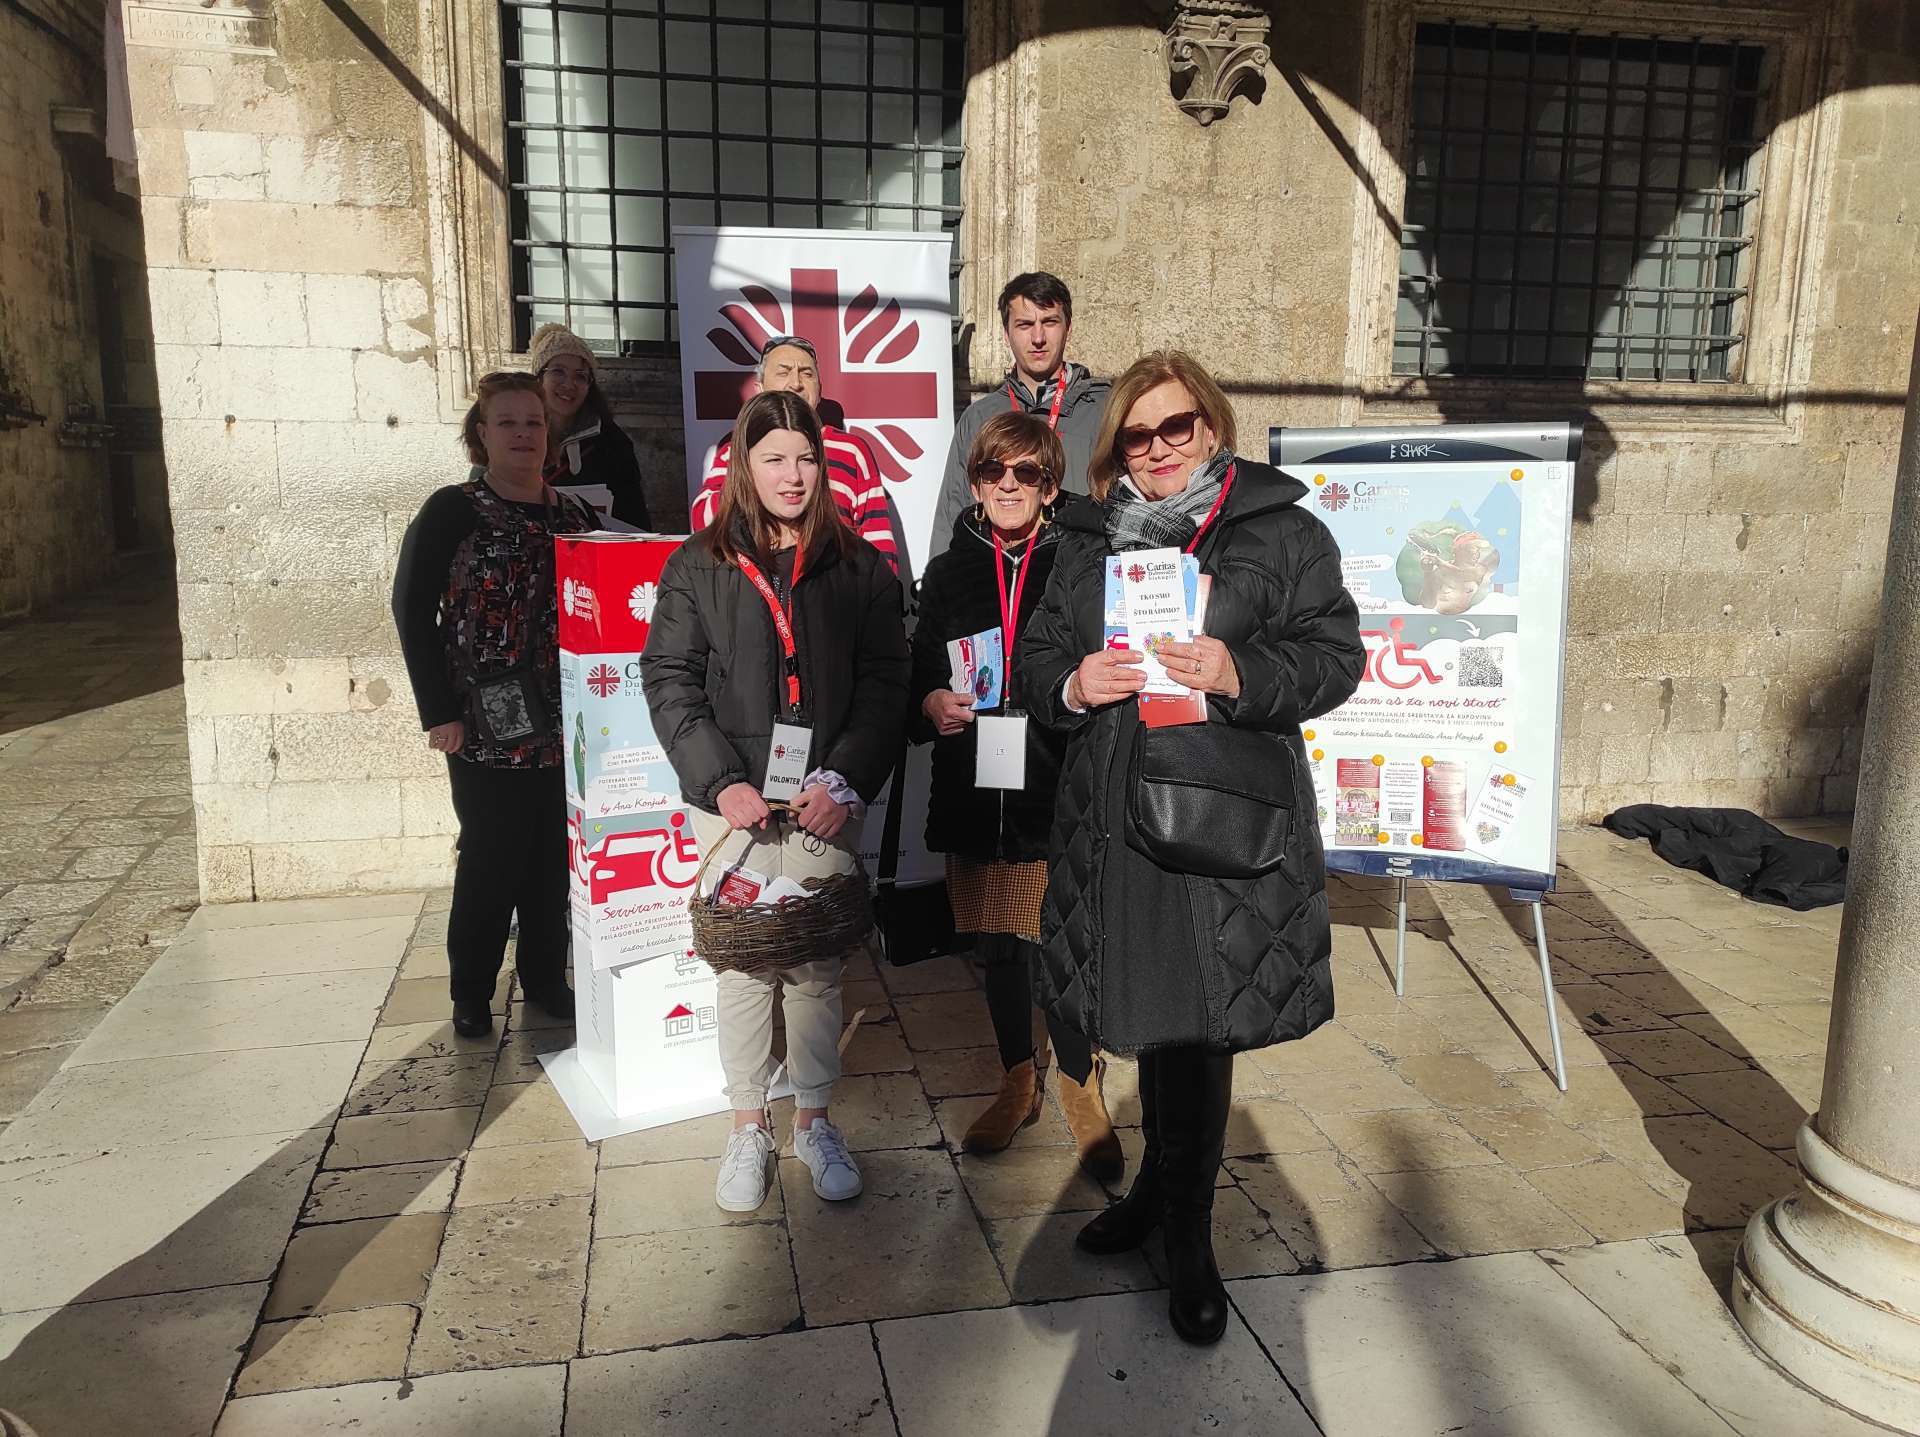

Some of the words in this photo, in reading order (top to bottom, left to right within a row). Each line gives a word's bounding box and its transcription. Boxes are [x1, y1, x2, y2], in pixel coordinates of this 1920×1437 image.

[1400, 443, 1451, 458] SHARK
[1146, 561, 1176, 572] Caritas
[754, 574, 775, 599] caritas
[776, 610, 790, 639] caritas
[1406, 697, 1425, 706] za
[1429, 697, 1460, 708] novi
[769, 774, 801, 785] VOLONTER
[600, 804, 611, 815] by
[612, 802, 633, 811] Ana
[634, 796, 668, 810] Konjuh
[668, 896, 686, 908] as
[609, 923, 633, 932] IZAZOV
[644, 912, 688, 924] PRIKUPLJANJE
